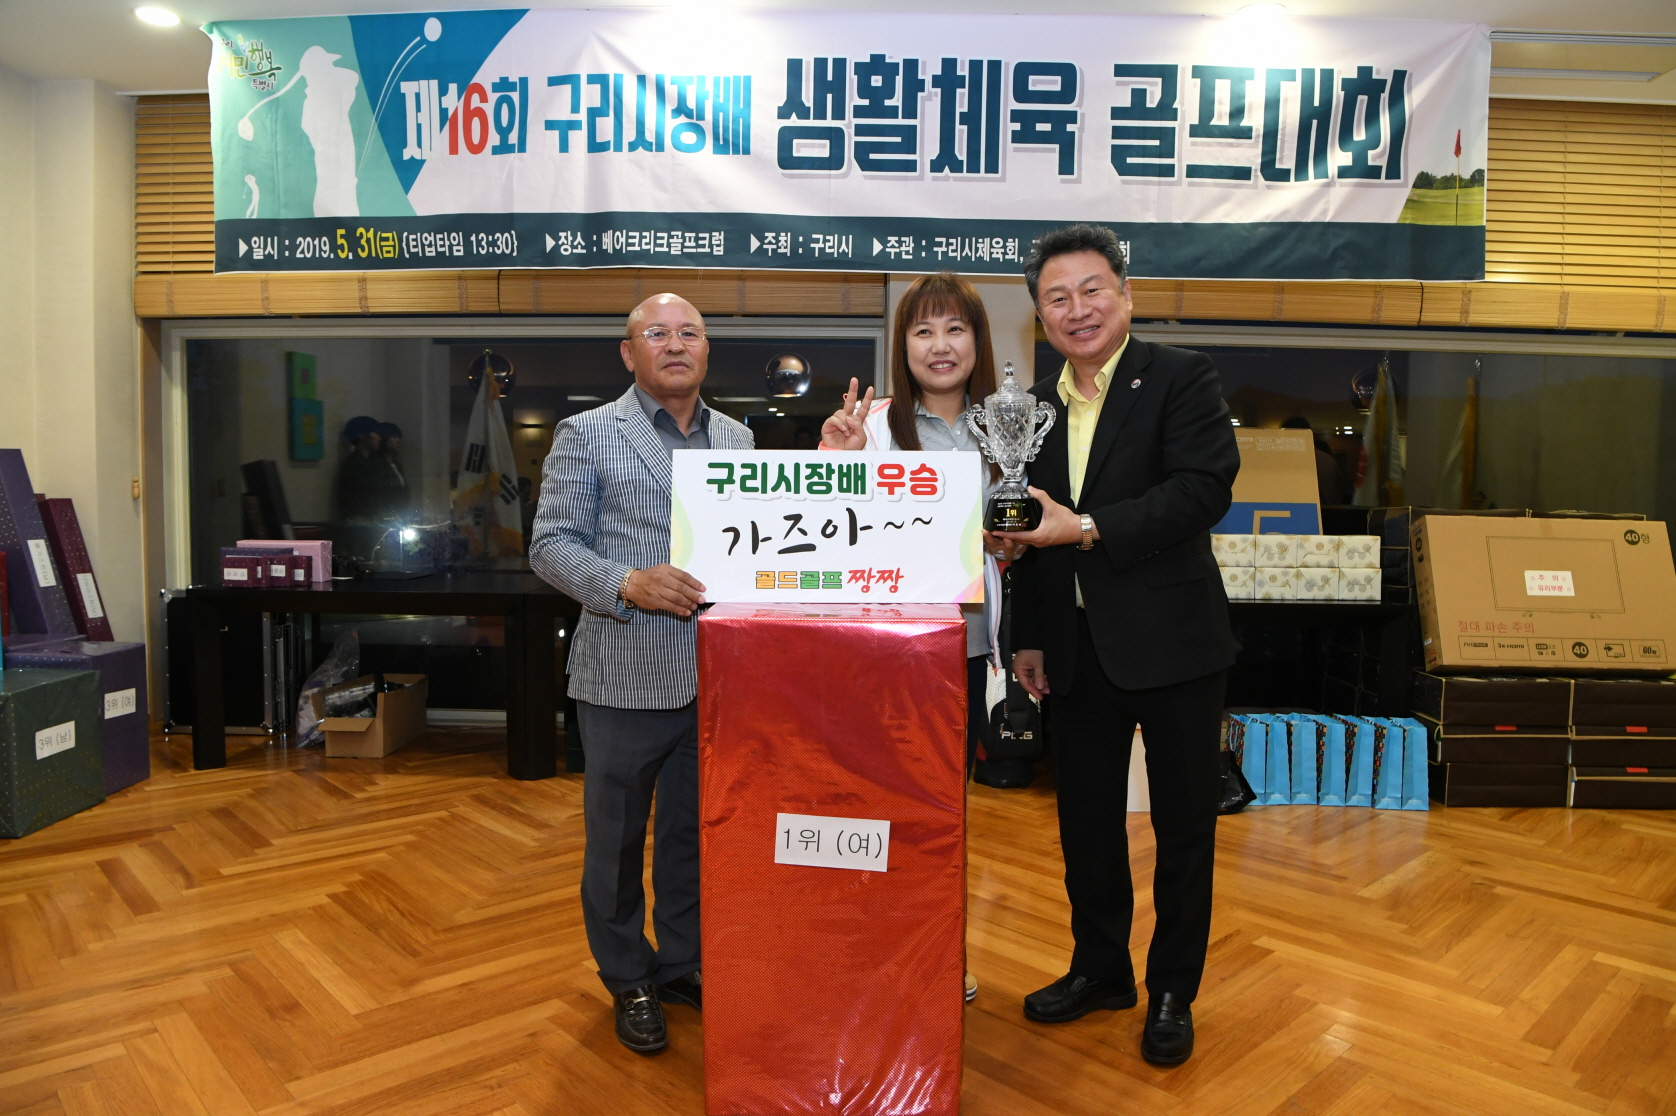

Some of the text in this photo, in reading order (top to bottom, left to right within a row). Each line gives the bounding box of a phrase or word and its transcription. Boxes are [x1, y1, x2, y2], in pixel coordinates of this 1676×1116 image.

[399, 53, 1410, 183] 제16회 구리시장배 생활체육 골프대회
[250, 235, 278, 260] 일시
[295, 236, 334, 259] 2019.
[356, 226, 399, 260] 31(금)
[402, 230, 464, 257] {티업타임
[469, 229, 518, 257] 13:30}
[557, 230, 587, 256] 장소
[601, 229, 725, 256] 베어크리크골프크럽
[762, 231, 792, 257] 주최
[809, 233, 853, 258] 구리시
[885, 235, 915, 260] 주관
[932, 236, 1024, 263] 구리시체육회,
[705, 461, 940, 497] 구리시장배 우승
[1005, 508, 1017, 518] 1위
[754, 566, 905, 594] 골드골프 짱짱
[1457, 620, 1535, 635] 절대 파손 주의
[1573, 645, 1588, 655] 40
[105, 694, 135, 712] 3위 (여)
[38, 729, 72, 751] 3위 (남)
[1001, 731, 1034, 740] PIG
[782, 826, 884, 859] 1위 (여)
